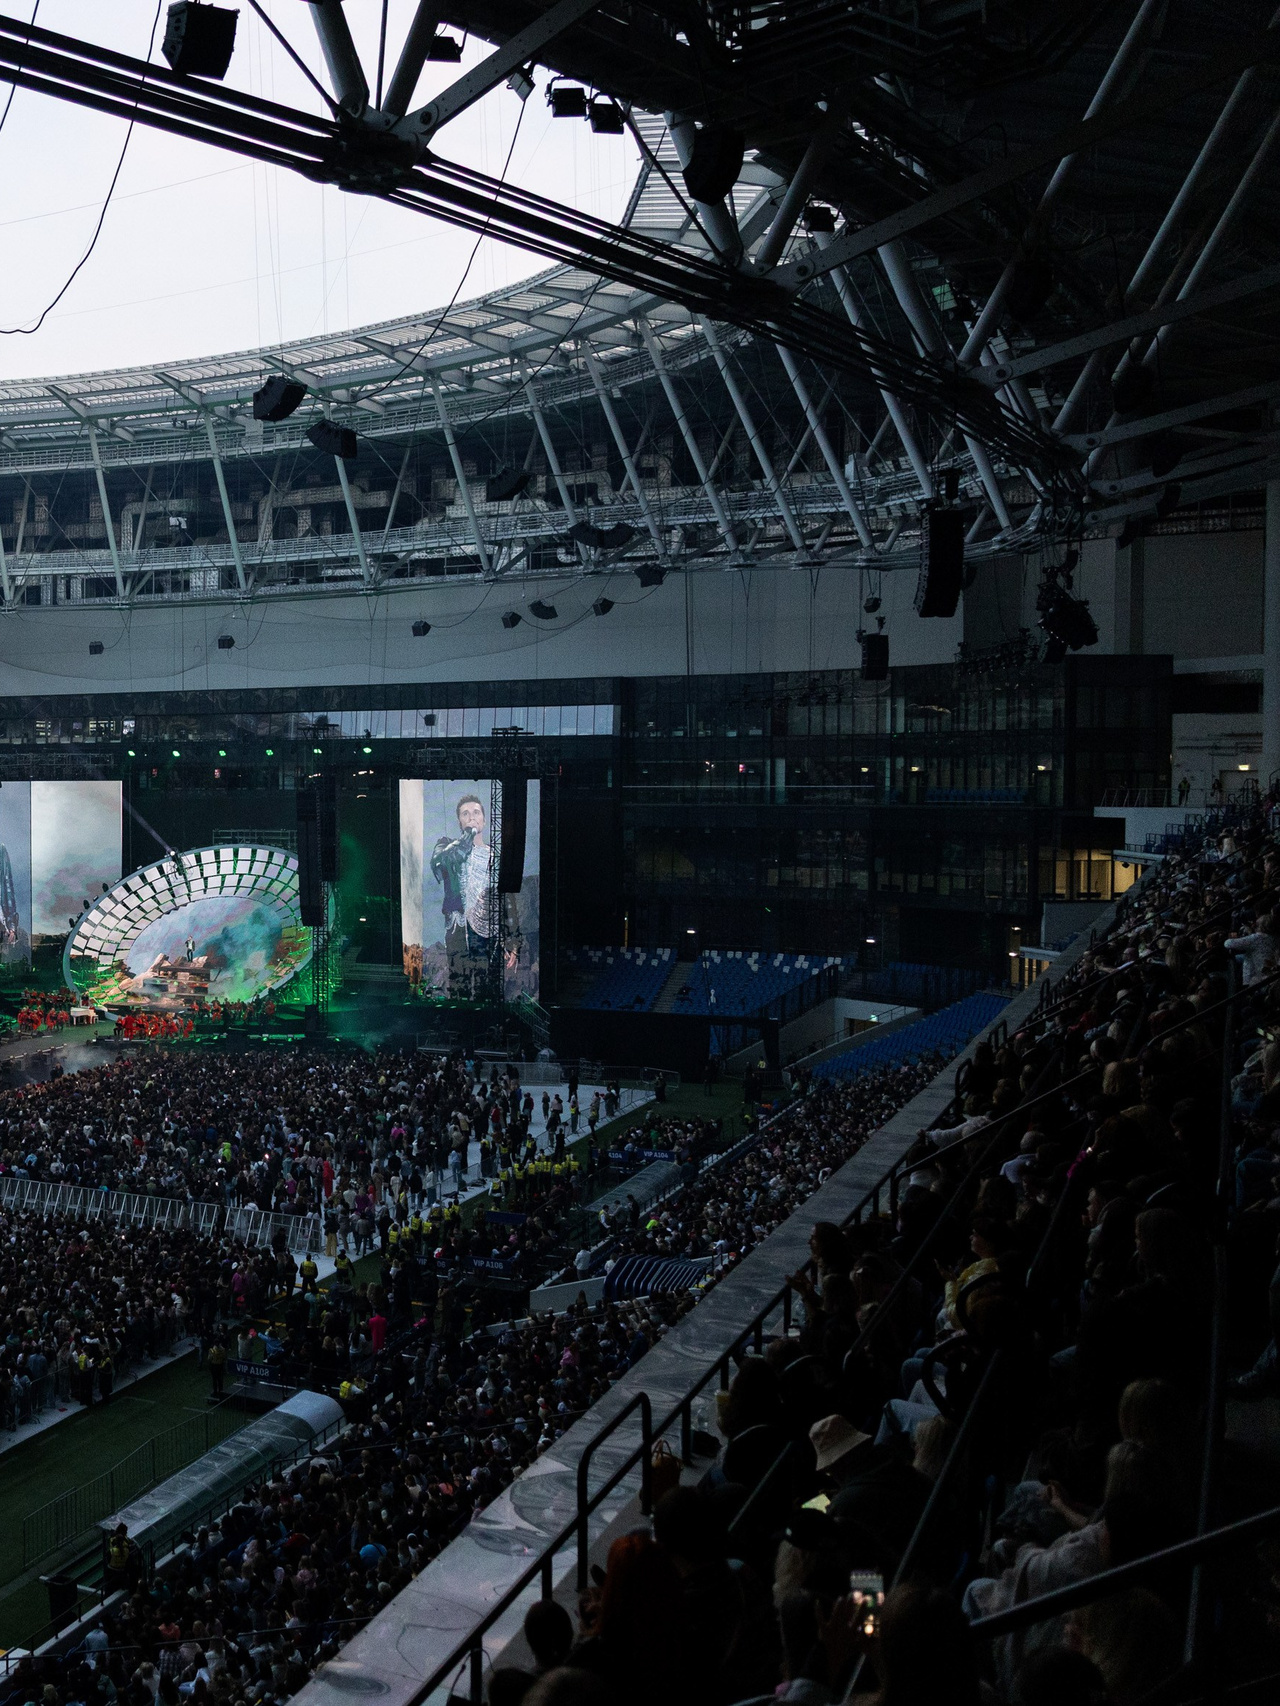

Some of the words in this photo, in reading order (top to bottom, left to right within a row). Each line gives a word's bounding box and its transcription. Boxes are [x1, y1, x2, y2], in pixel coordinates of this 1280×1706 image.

[473, 1259, 484, 1267] VIP
[236, 1363, 248, 1373] VIP
[250, 1366, 270, 1376] A108
